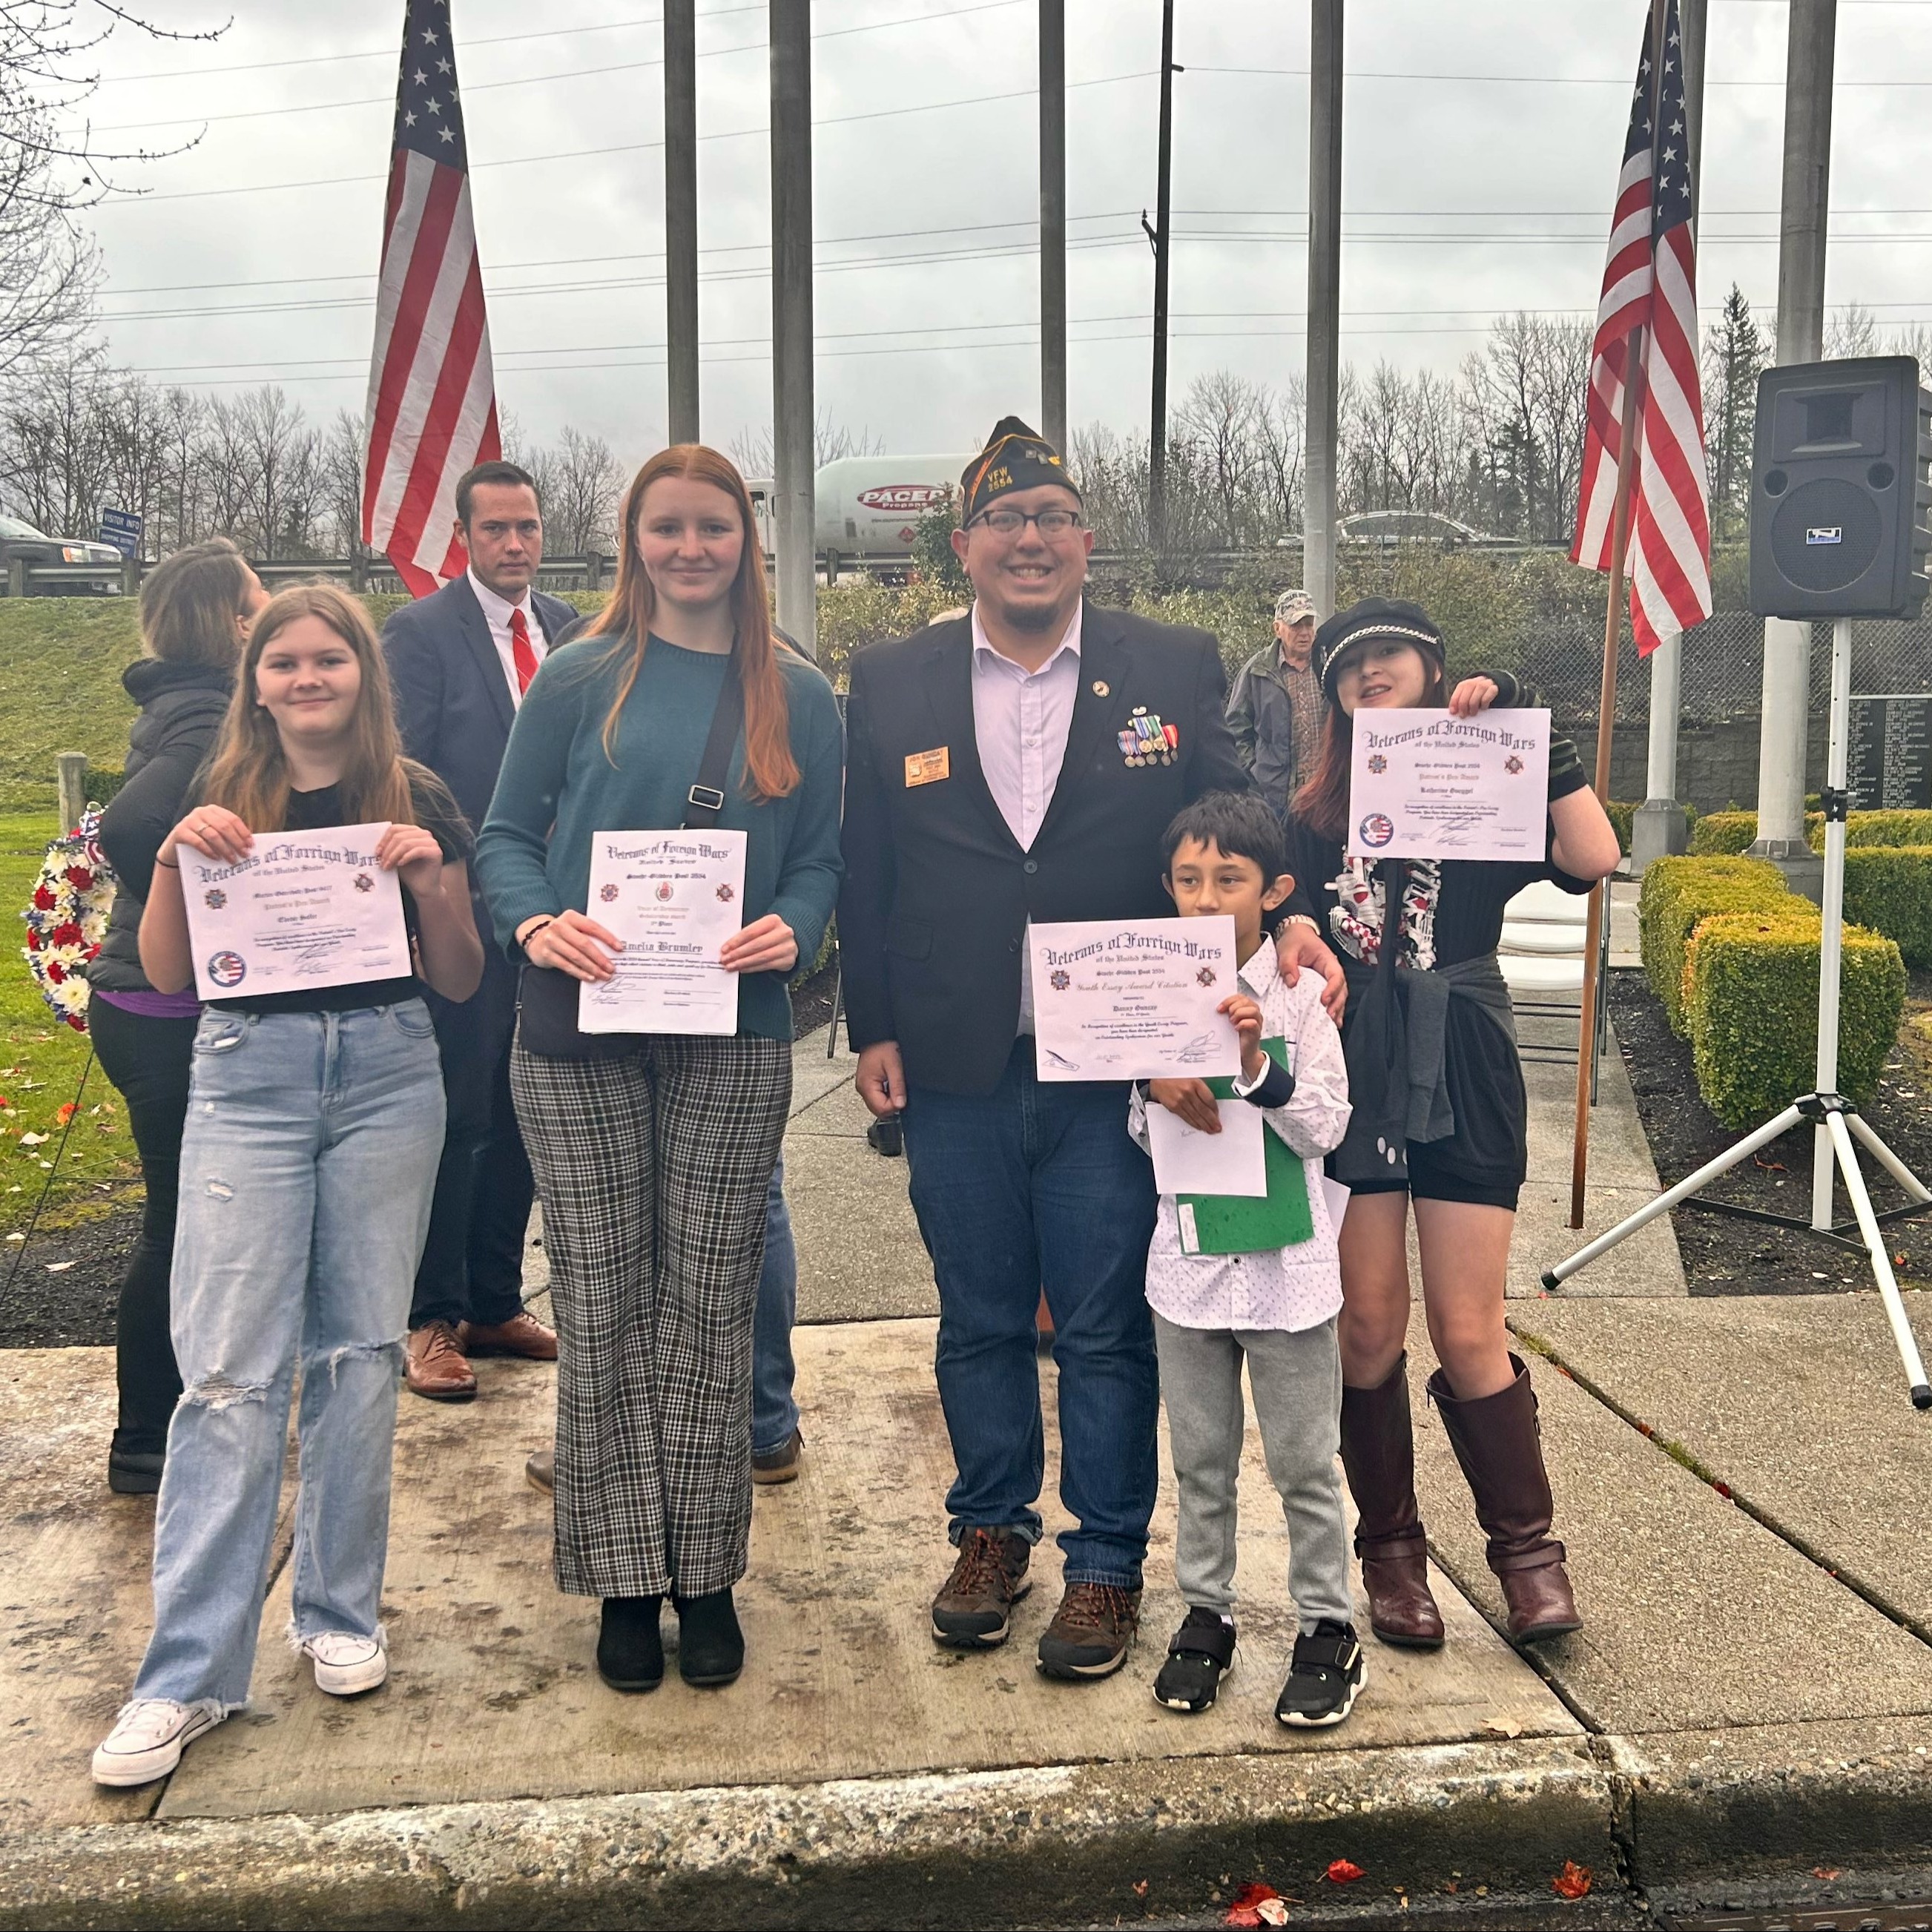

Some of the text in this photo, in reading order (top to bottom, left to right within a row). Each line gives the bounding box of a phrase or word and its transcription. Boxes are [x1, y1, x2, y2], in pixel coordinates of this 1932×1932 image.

[987, 466, 1009, 482] VFW
[988, 475, 1013, 493] 2554
[882, 501, 929, 510] Propane
[104, 512, 140, 530] VISITOR INFO
[1362, 719, 1536, 752] Veterans of Foreign Wars
[607, 840, 732, 862] Veterans of Foreign Wars
[194, 844, 382, 888] Veterans of Foreign Wars
[619, 940, 703, 953] Amelia Brumler
[1040, 932, 1222, 971] Veterans of Foreign Wars
[1116, 955, 1139, 963] United
[1141, 954, 1164, 962] States
[1076, 979, 1188, 993] Youth Essay Award Citation
